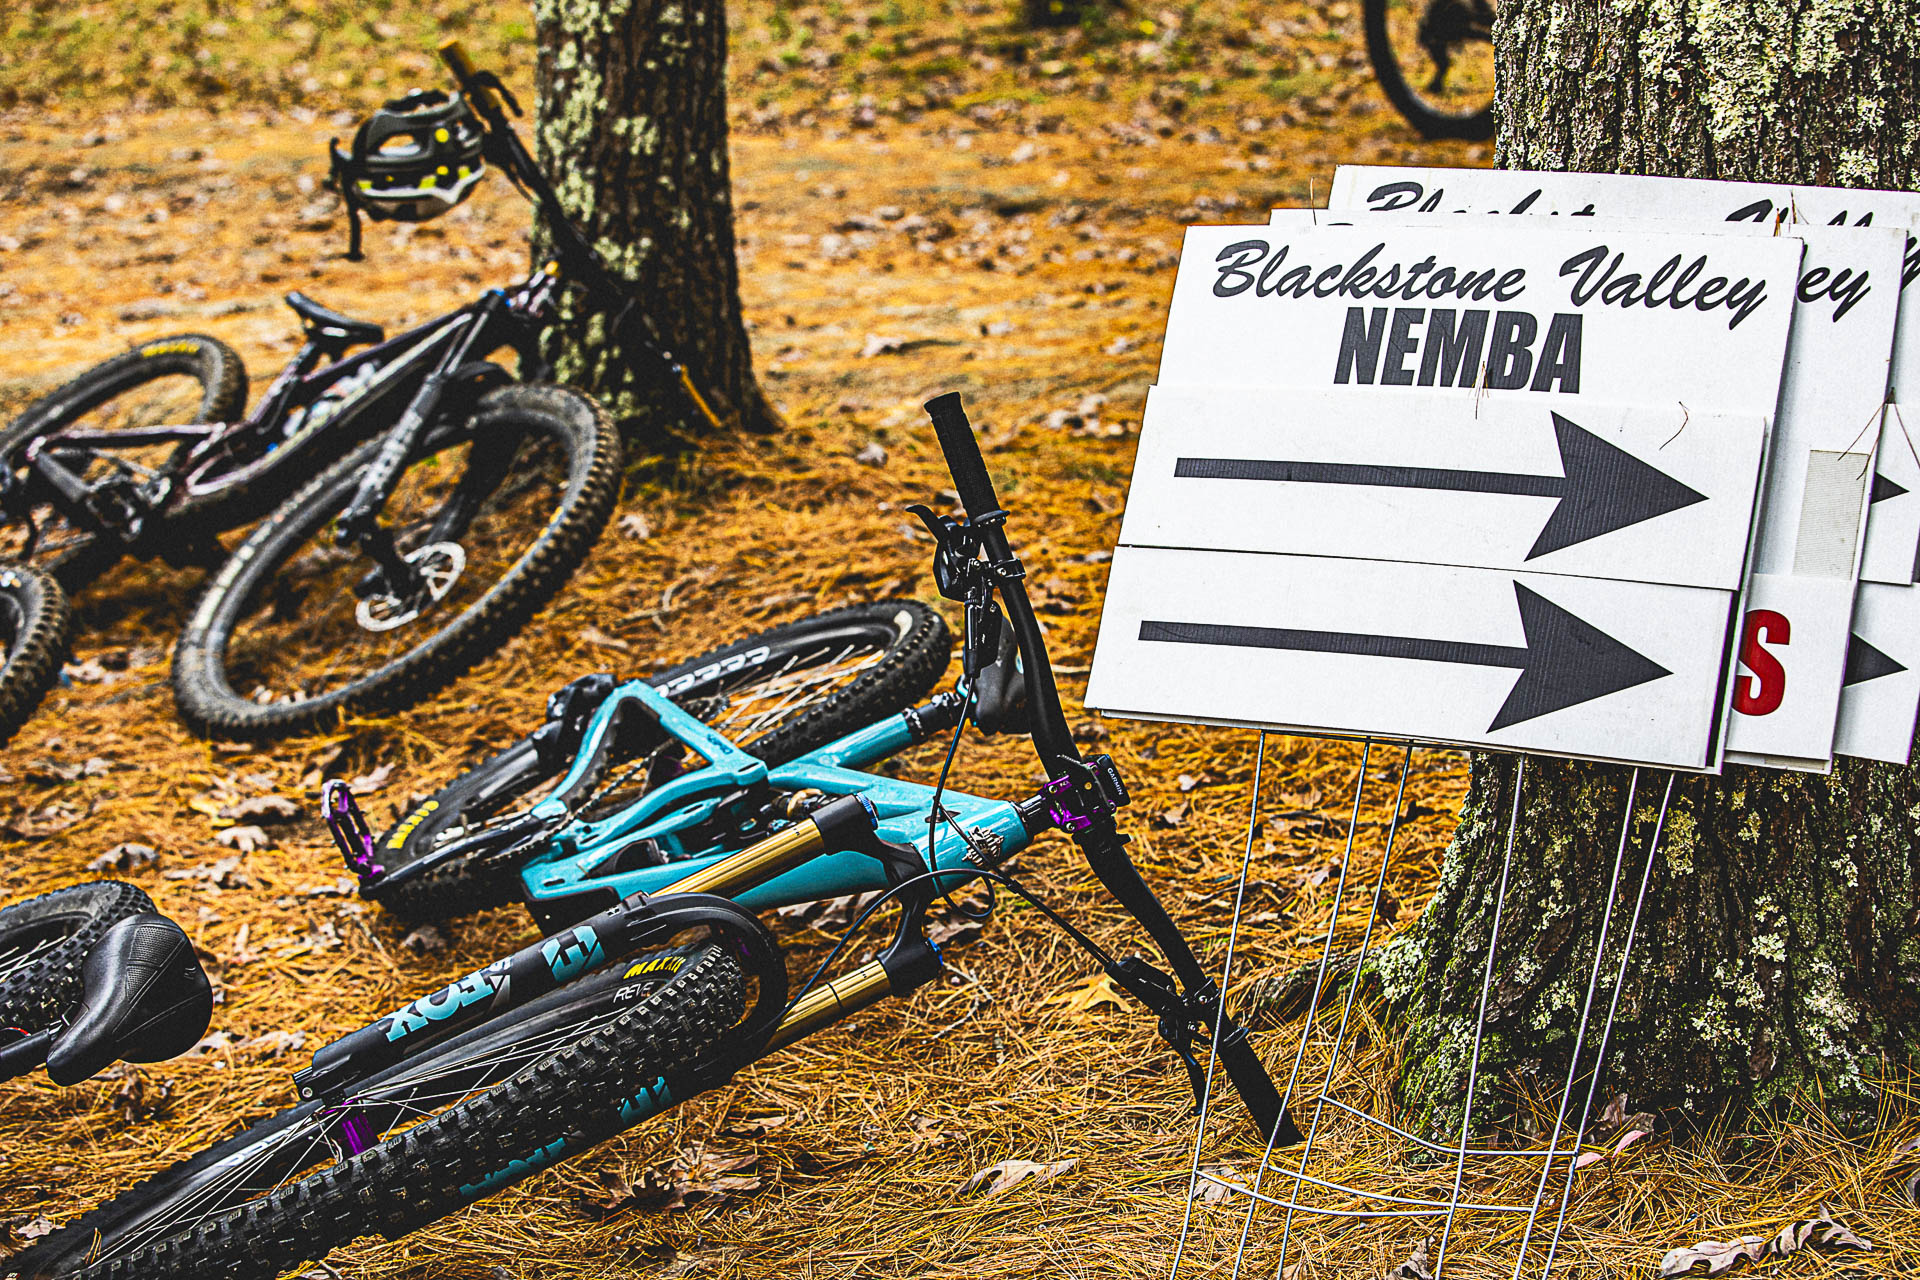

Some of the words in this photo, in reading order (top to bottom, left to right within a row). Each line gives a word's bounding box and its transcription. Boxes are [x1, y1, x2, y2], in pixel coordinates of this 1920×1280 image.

[1212, 239, 1527, 302] Blackstone
[1559, 244, 1768, 331] Valley
[1333, 306, 1584, 394] NEMBA
[1107, 767, 1124, 796] GARMIN
